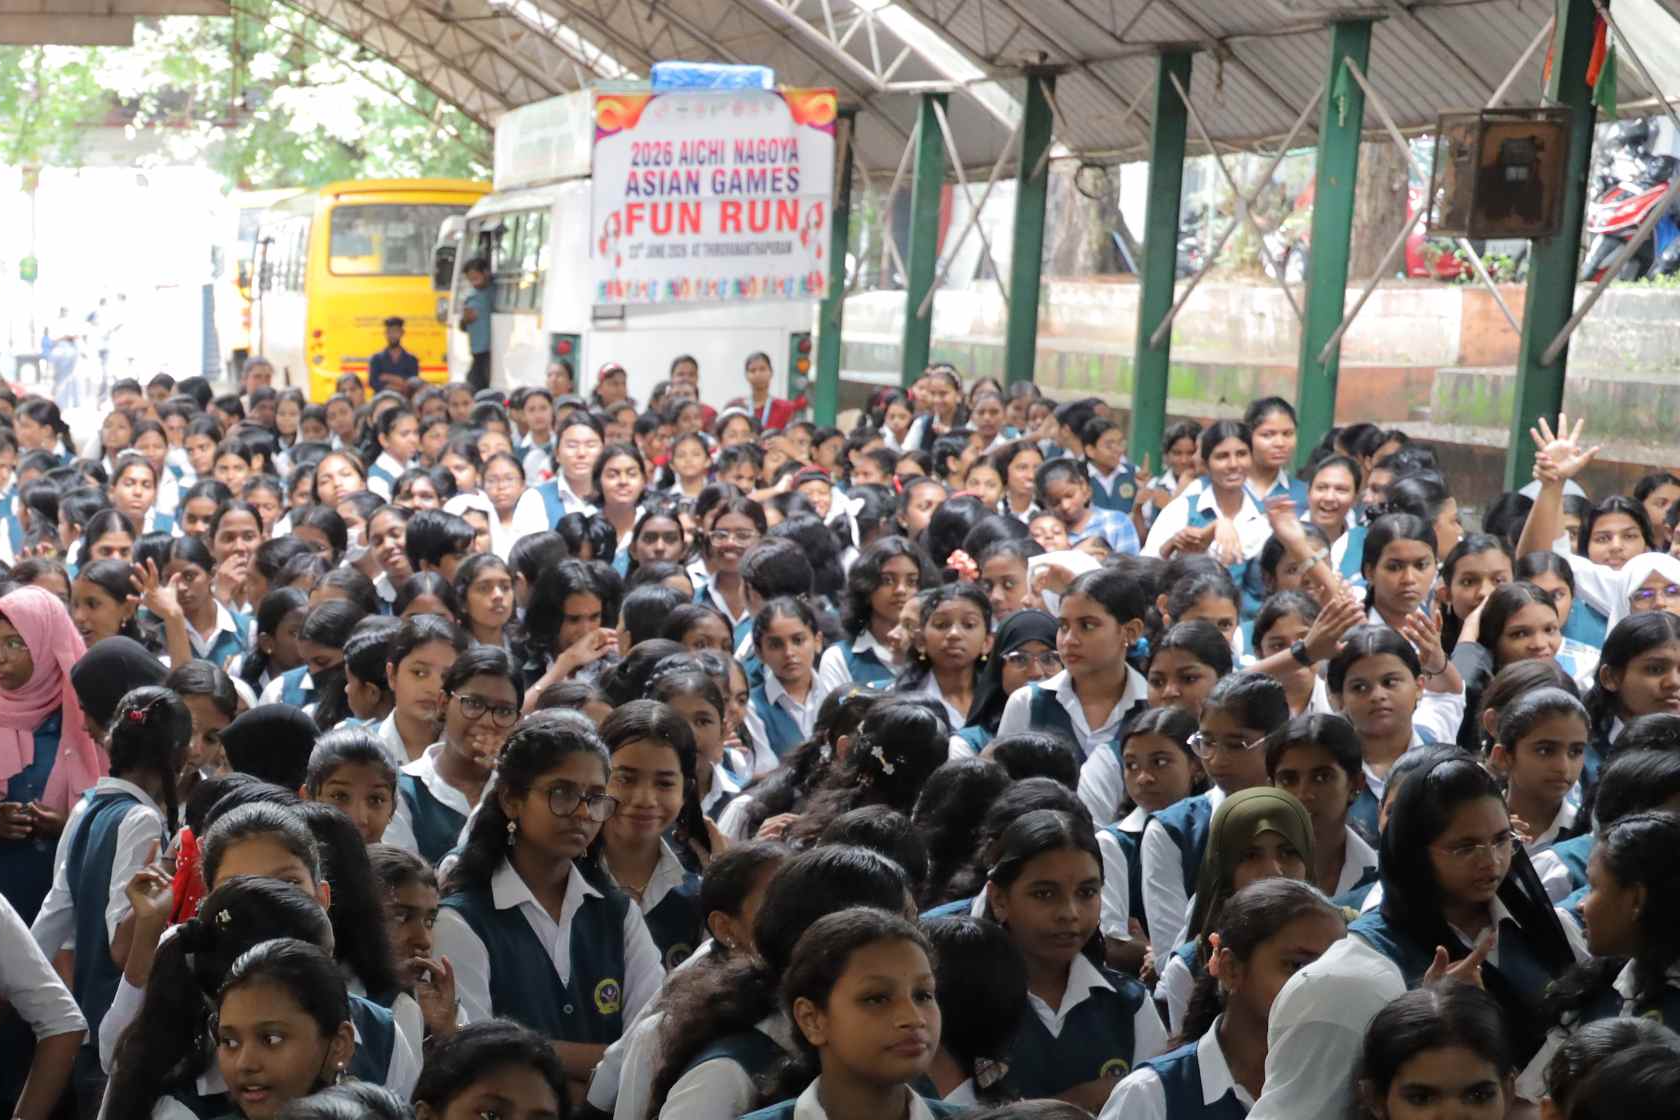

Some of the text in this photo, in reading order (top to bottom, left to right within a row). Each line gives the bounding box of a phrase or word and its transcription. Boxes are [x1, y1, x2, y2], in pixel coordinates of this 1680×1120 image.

[631, 138, 800, 167] 2026 AICHI NAGOYA
[625, 166, 801, 197] ASIAN GAMES
[625, 198, 801, 236] FUN RUN
